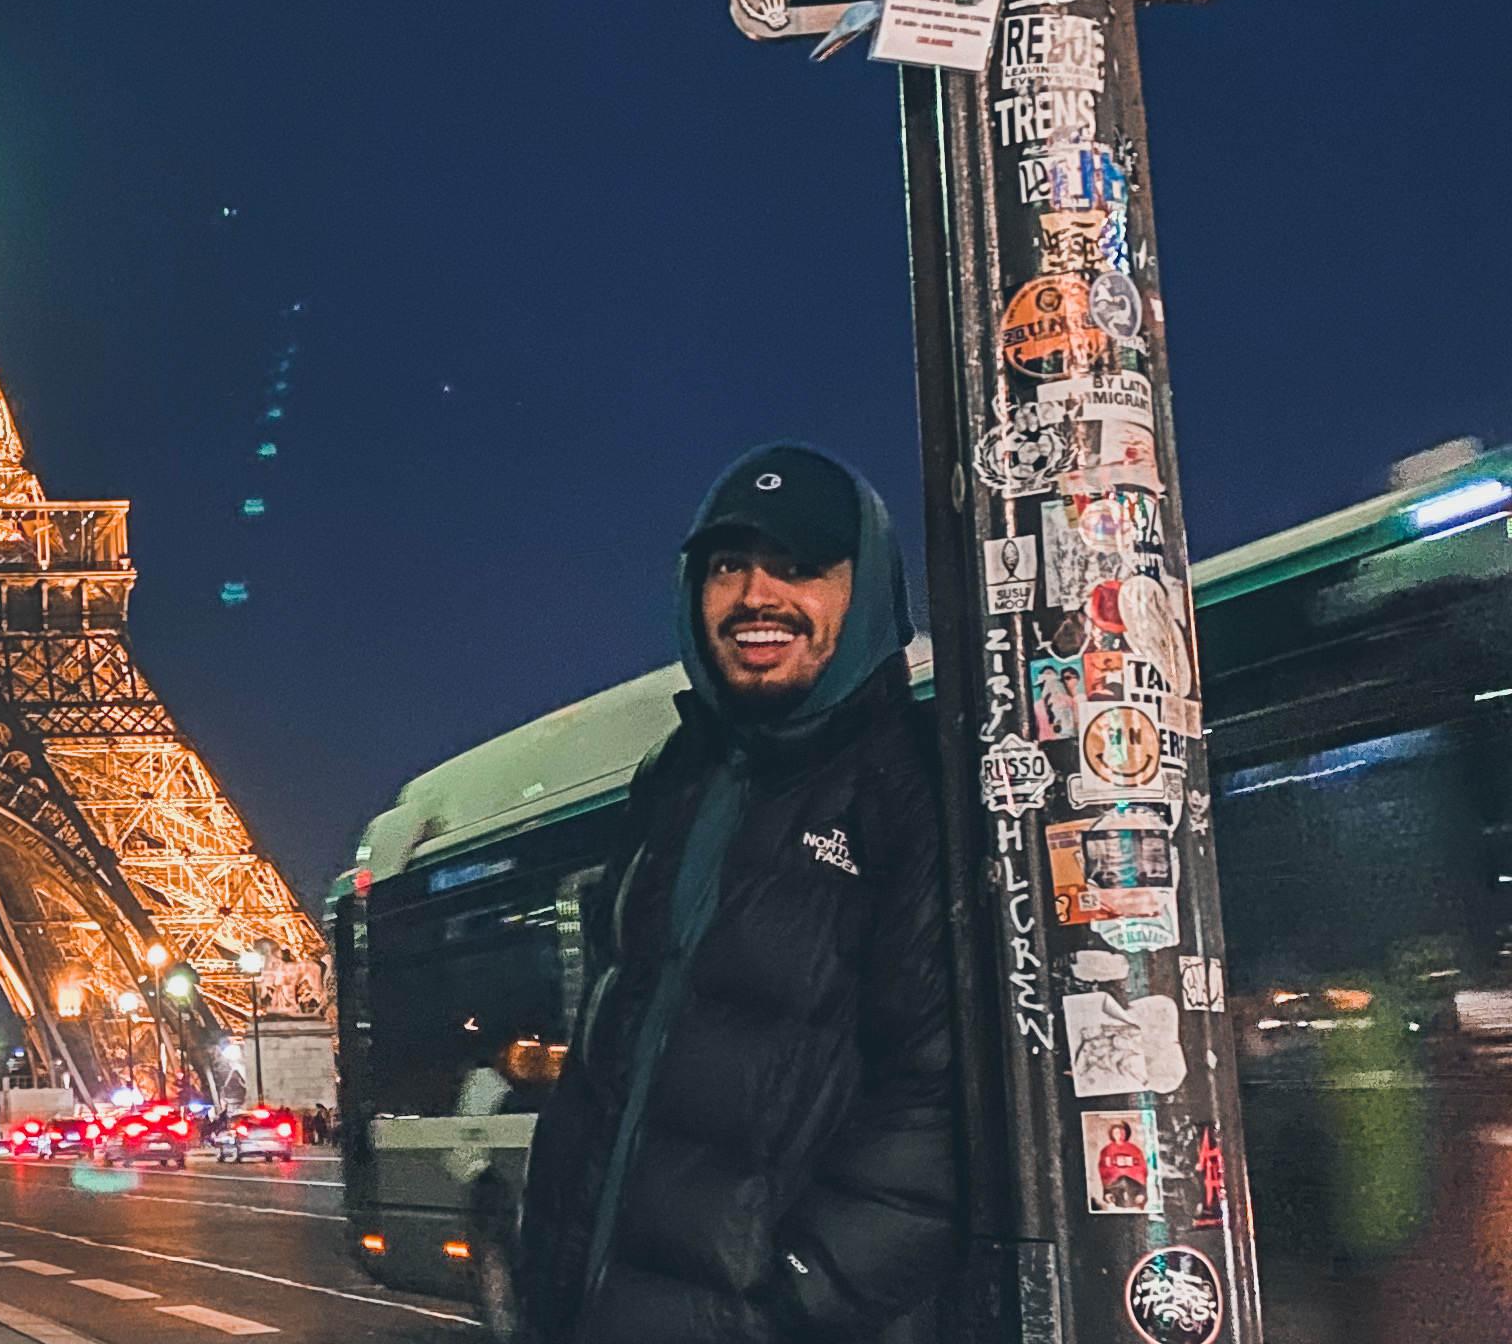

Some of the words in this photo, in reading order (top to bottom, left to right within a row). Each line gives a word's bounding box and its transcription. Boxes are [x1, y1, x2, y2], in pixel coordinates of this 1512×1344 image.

[1093, 374, 1114, 390] BY
[984, 755, 1046, 778] RUSSO
[814, 847, 854, 872] FACE
